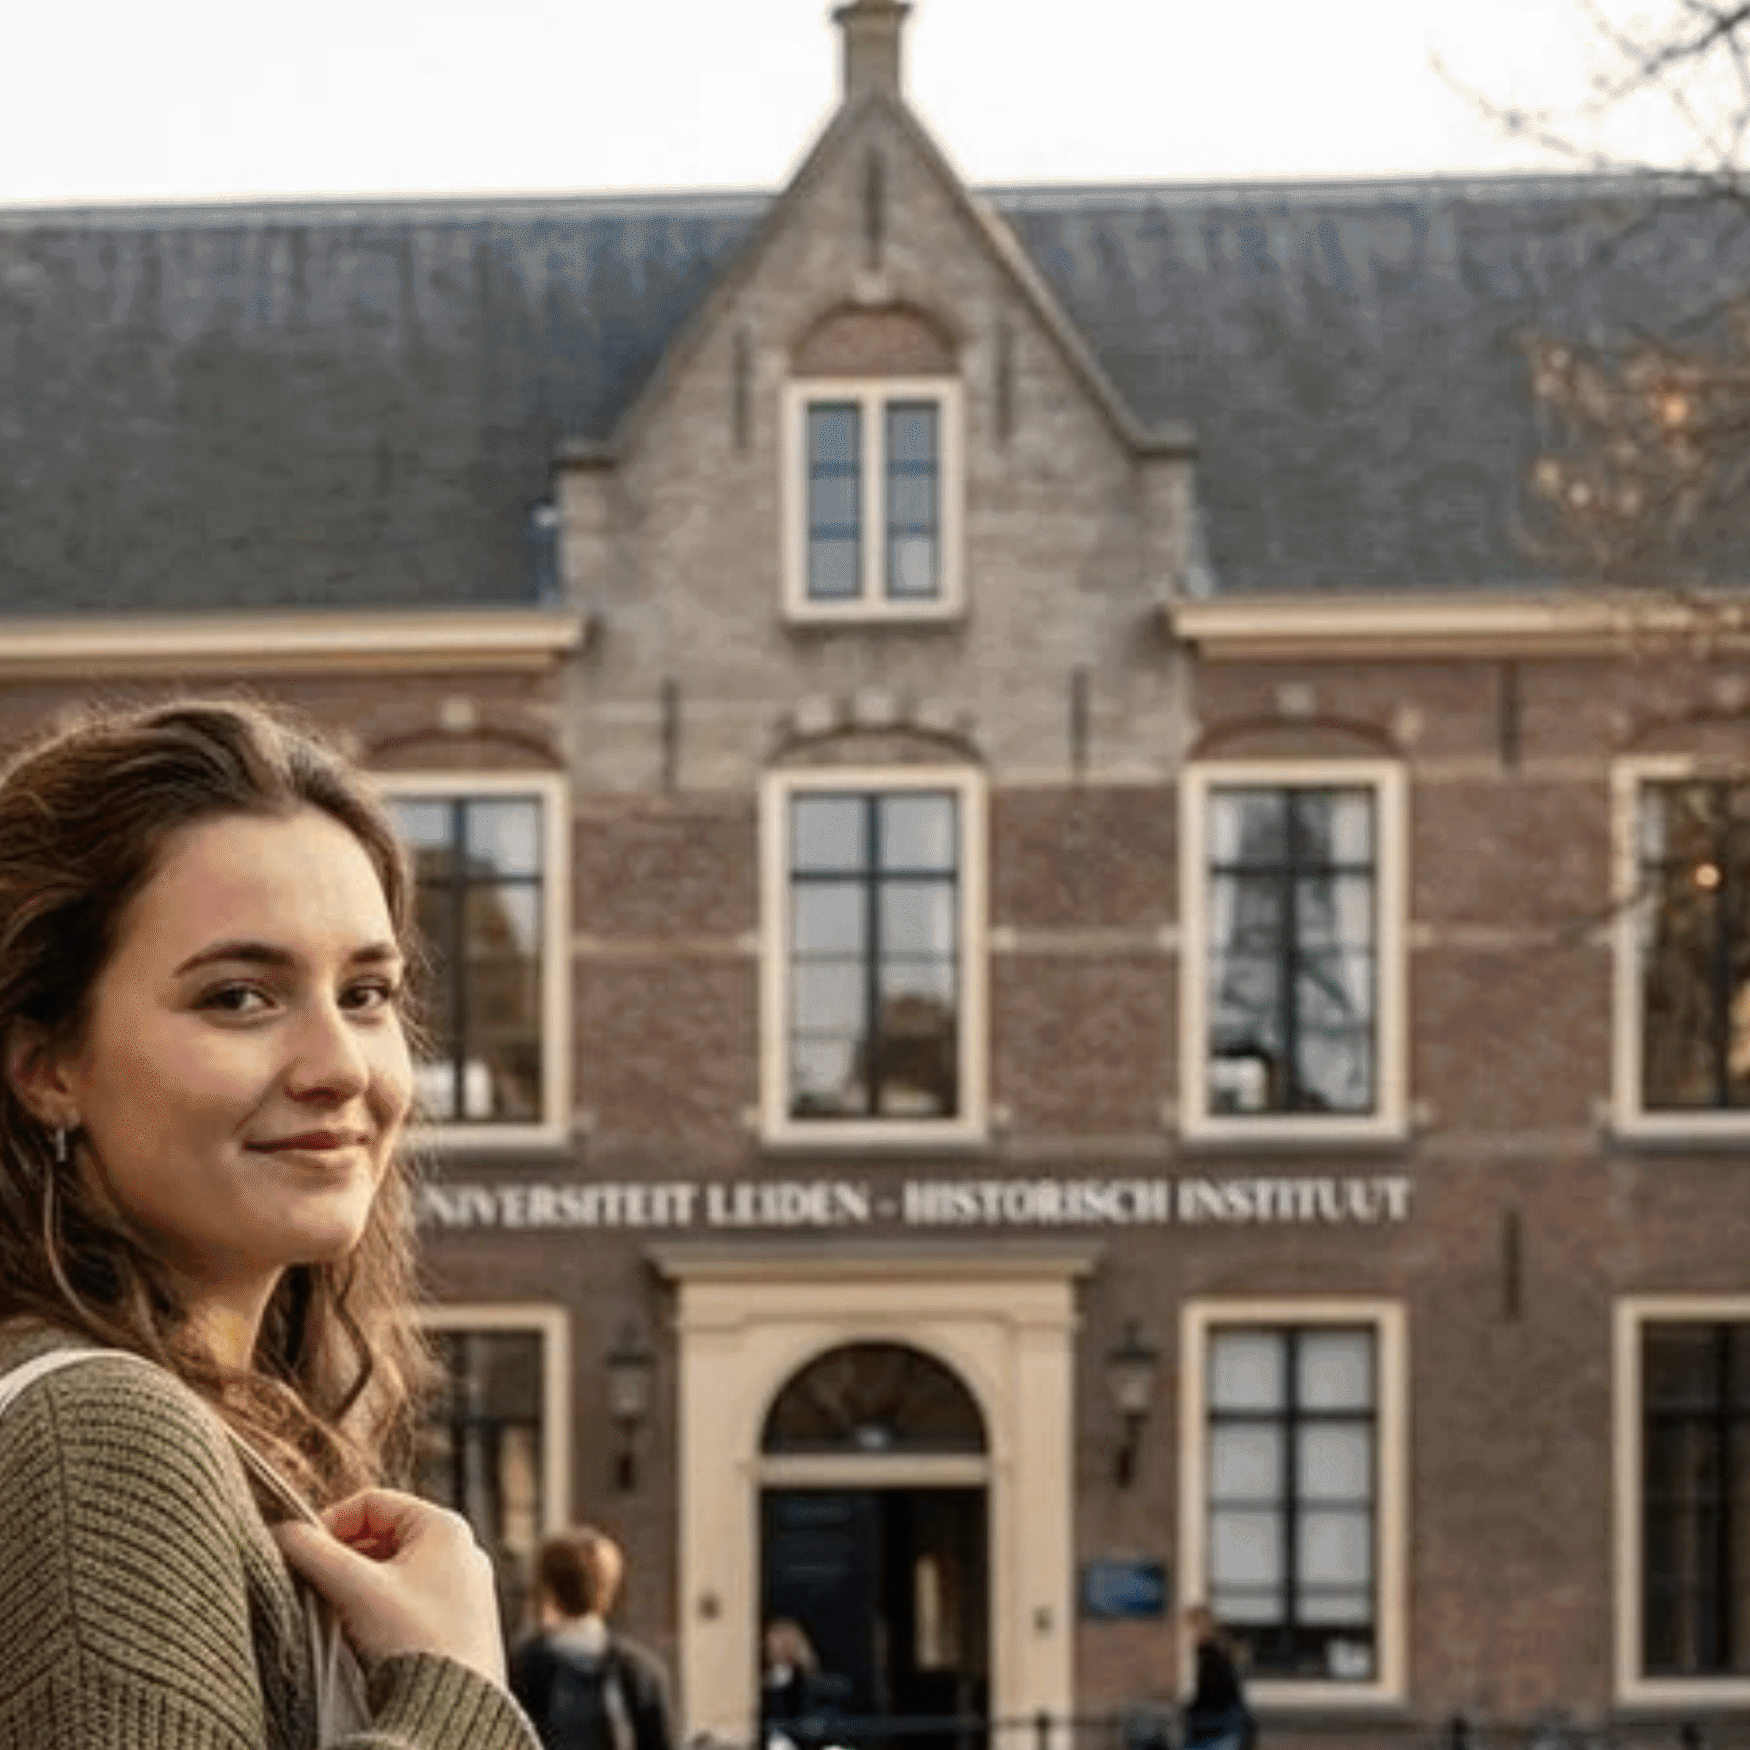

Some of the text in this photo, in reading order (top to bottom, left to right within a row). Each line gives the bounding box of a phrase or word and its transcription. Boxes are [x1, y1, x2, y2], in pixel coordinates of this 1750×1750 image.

[418, 1183, 698, 1227] NIVERSITEIT
[706, 1182, 870, 1226] LEIDEN
[903, 1179, 1169, 1224] HISTORISCH
